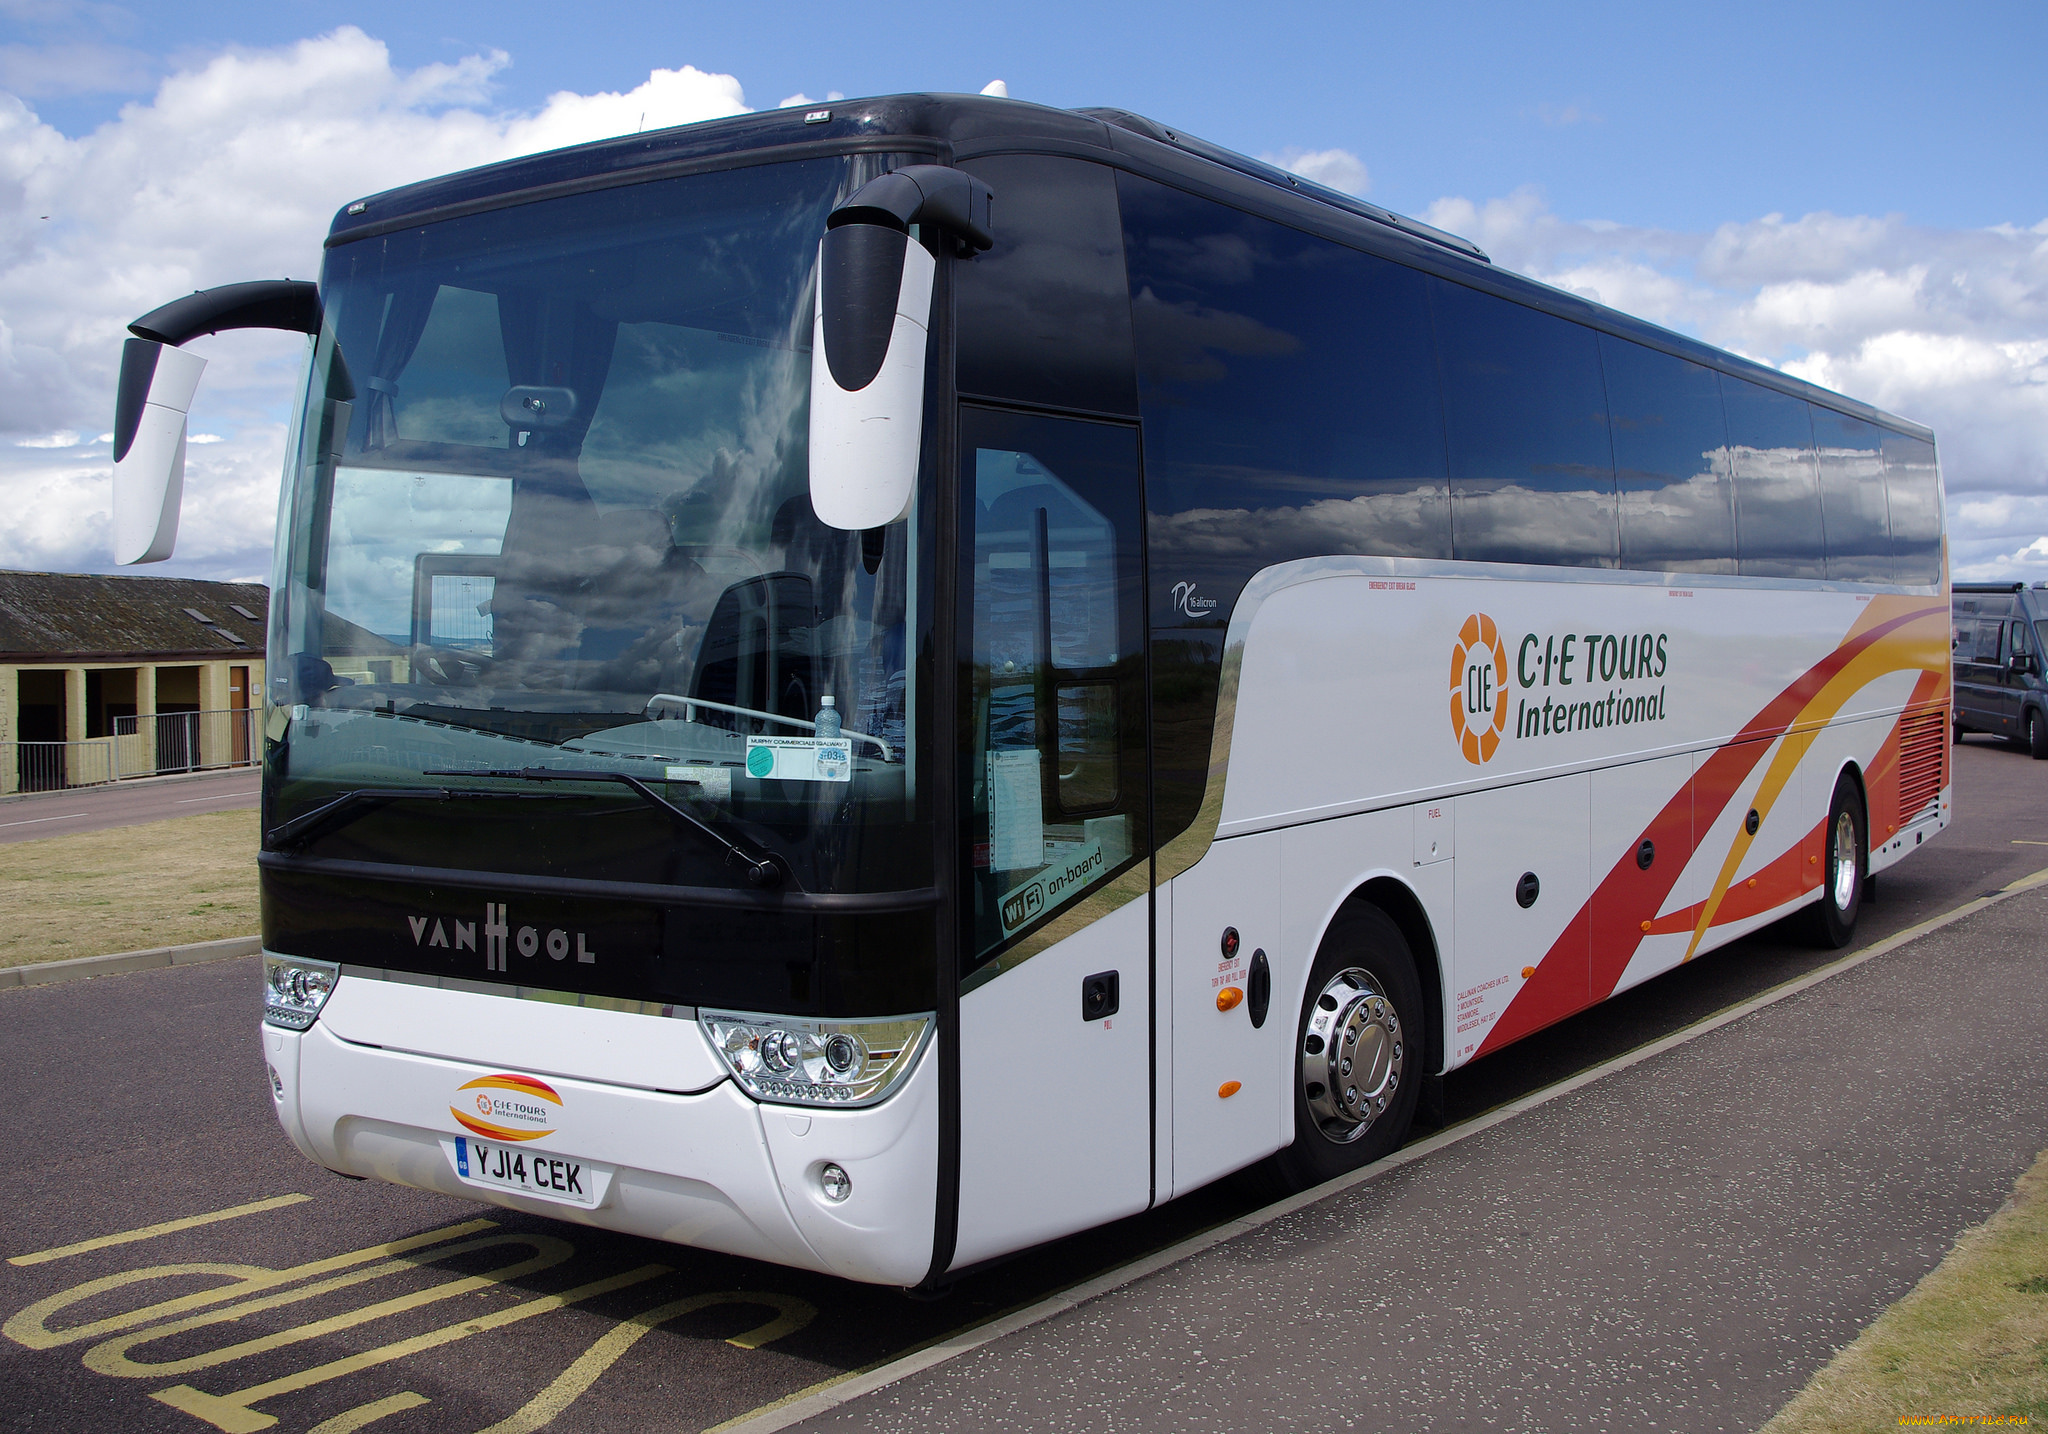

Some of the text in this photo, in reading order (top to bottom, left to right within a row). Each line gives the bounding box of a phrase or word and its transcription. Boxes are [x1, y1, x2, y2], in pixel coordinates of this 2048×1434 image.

[1583, 633, 1668, 683] TOURS
[1468, 663, 1491, 714] CIE
[1516, 684, 1666, 739] International
[750, 738, 773, 746] MURPHY
[773, 739, 816, 747] COMMERCIALS
[1049, 846, 1103, 895] on-board
[495, 1109, 548, 1124] International
[514, 1103, 546, 1117] TOURS
[475, 1144, 583, 1195] YJ14 CEK
